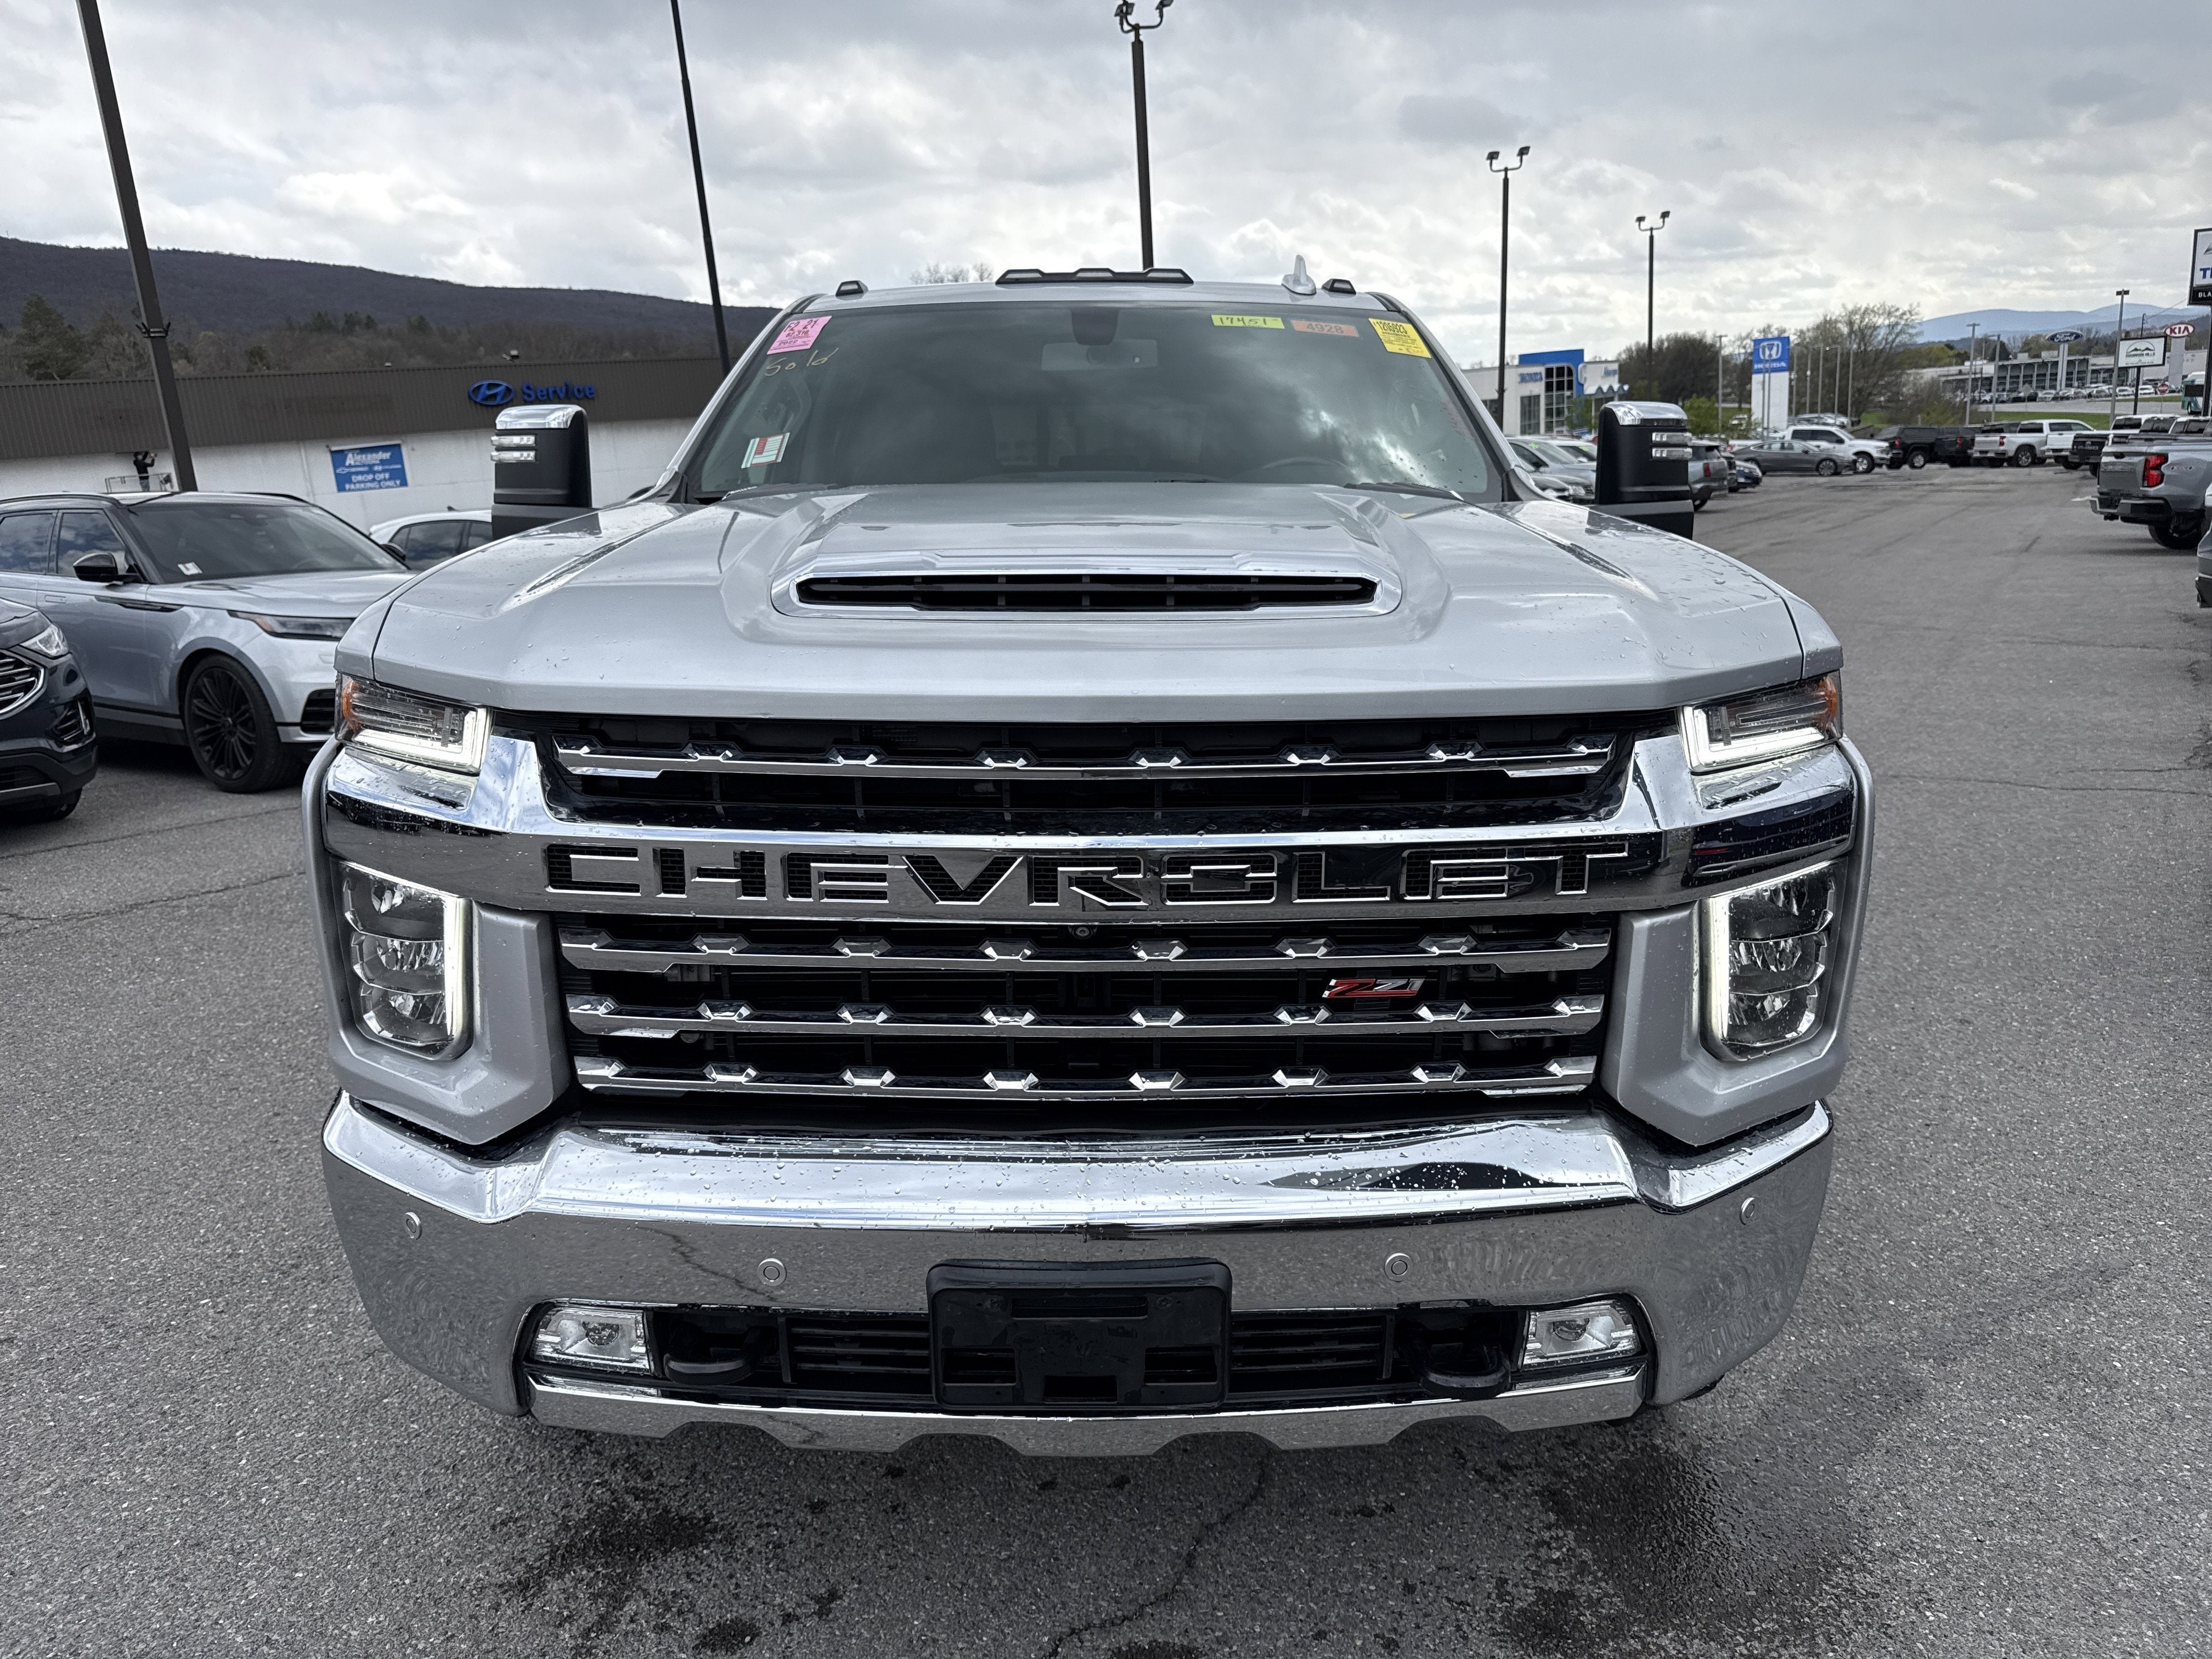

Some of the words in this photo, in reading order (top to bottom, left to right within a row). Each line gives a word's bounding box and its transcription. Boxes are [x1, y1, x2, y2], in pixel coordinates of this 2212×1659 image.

[2200, 267, 2212, 279] T
[1220, 317, 1267, 327] 17451
[1306, 322, 1344, 335] 4928
[2169, 326, 2191, 335] KIA
[2054, 332, 2076, 342] Ford
[764, 347, 839, 377] Sold
[522, 380, 596, 402] Service
[346, 452, 391, 466] Alexander
[352, 473, 374, 482] DROP
[375, 472, 390, 481] OFF
[345, 481, 380, 490] PARKING
[380, 479, 400, 488] ONLY
[544, 842, 1628, 906] CHEVROLET
[1322, 978, 1425, 998] Z71
